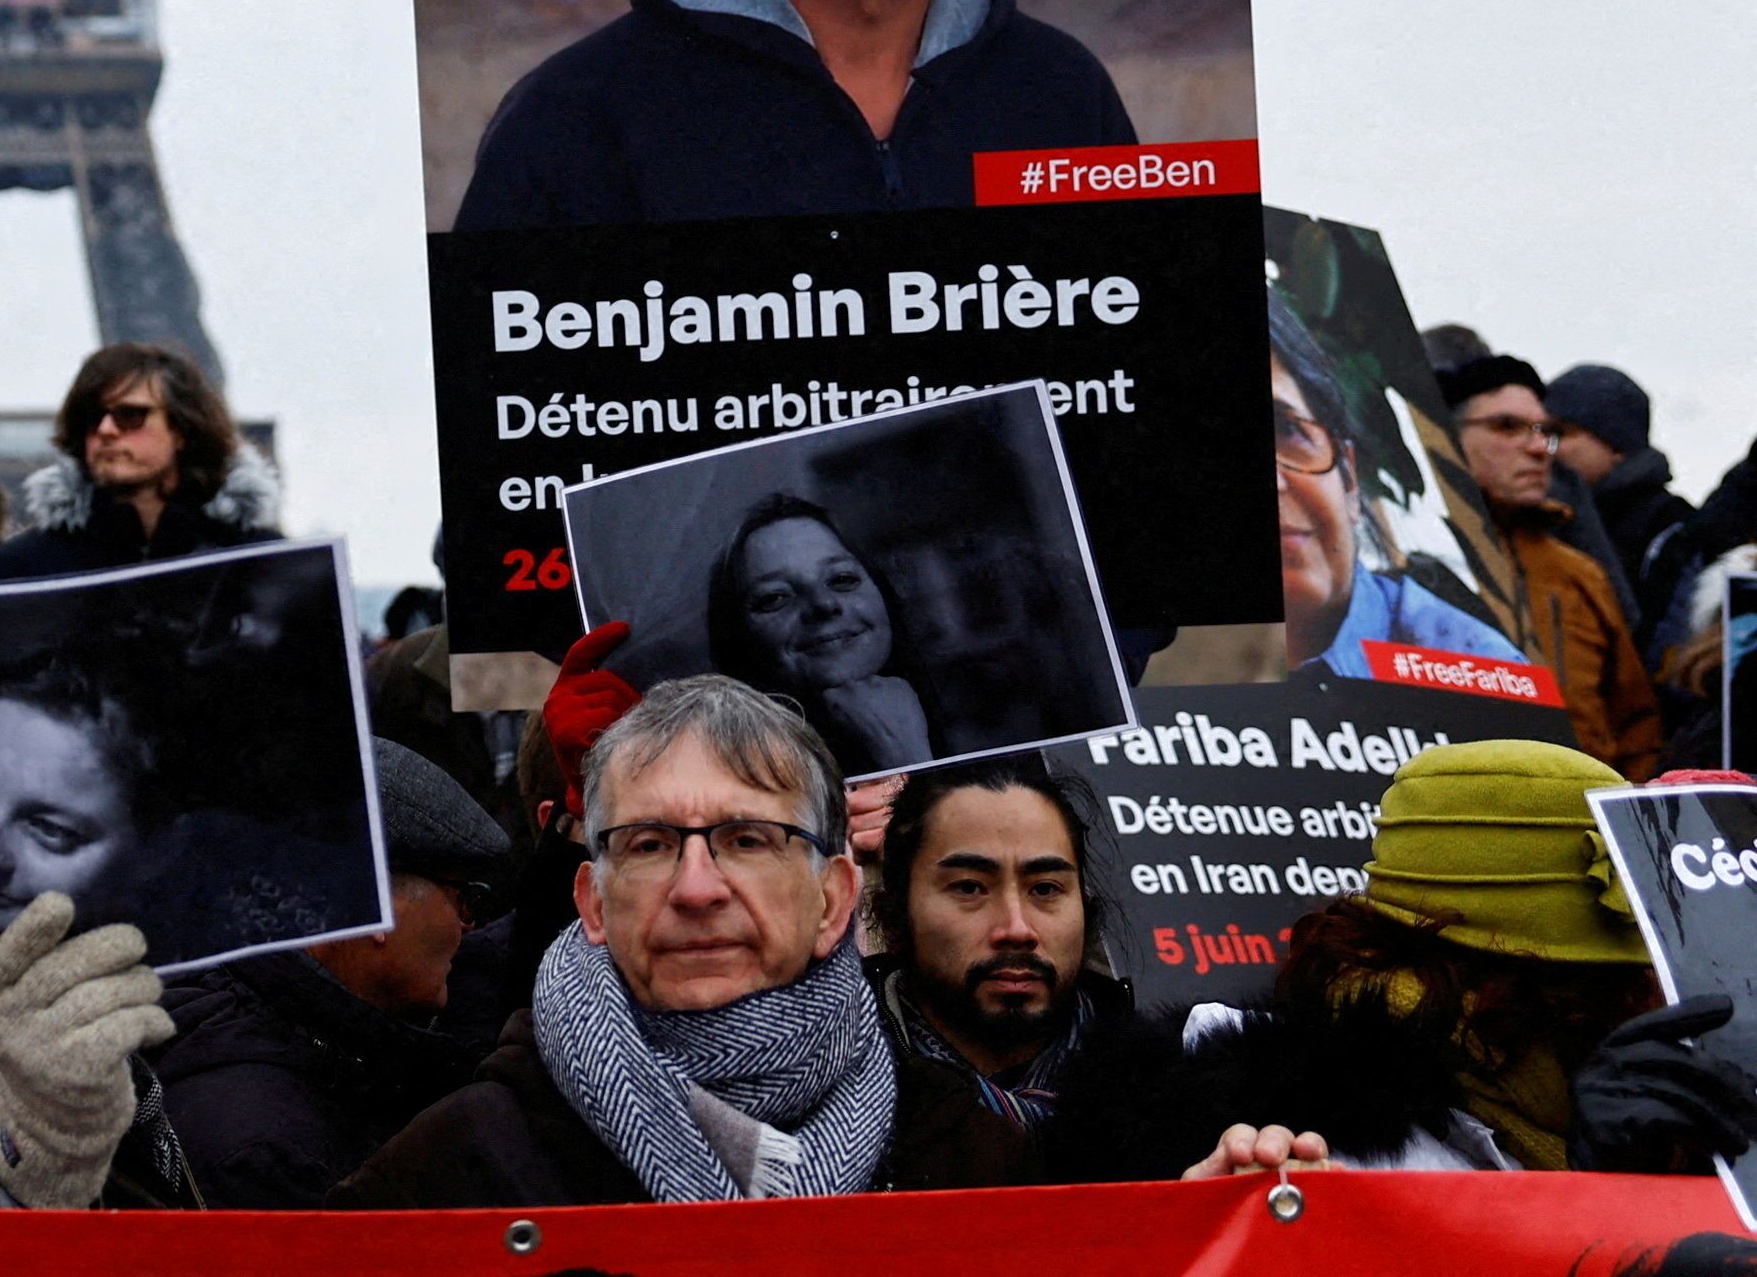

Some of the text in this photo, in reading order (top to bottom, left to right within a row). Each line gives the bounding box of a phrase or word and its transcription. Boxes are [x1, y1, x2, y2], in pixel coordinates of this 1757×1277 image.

[1020, 154, 1216, 194] #FreeBen
[492, 264, 1140, 362] Benjamin Brière
[496, 370, 1136, 440] Détenu arbitraient
[498, 475, 564, 512] en
[503, 548, 572, 591] 26
[1393, 651, 1539, 698] #FreeFariba
[1106, 795, 1295, 837] Détenue
[1130, 863, 1189, 895] en
[1191, 854, 1281, 895] Iran
[1671, 837, 1757, 891] Céc
[1152, 923, 1277, 975] 5 juin
